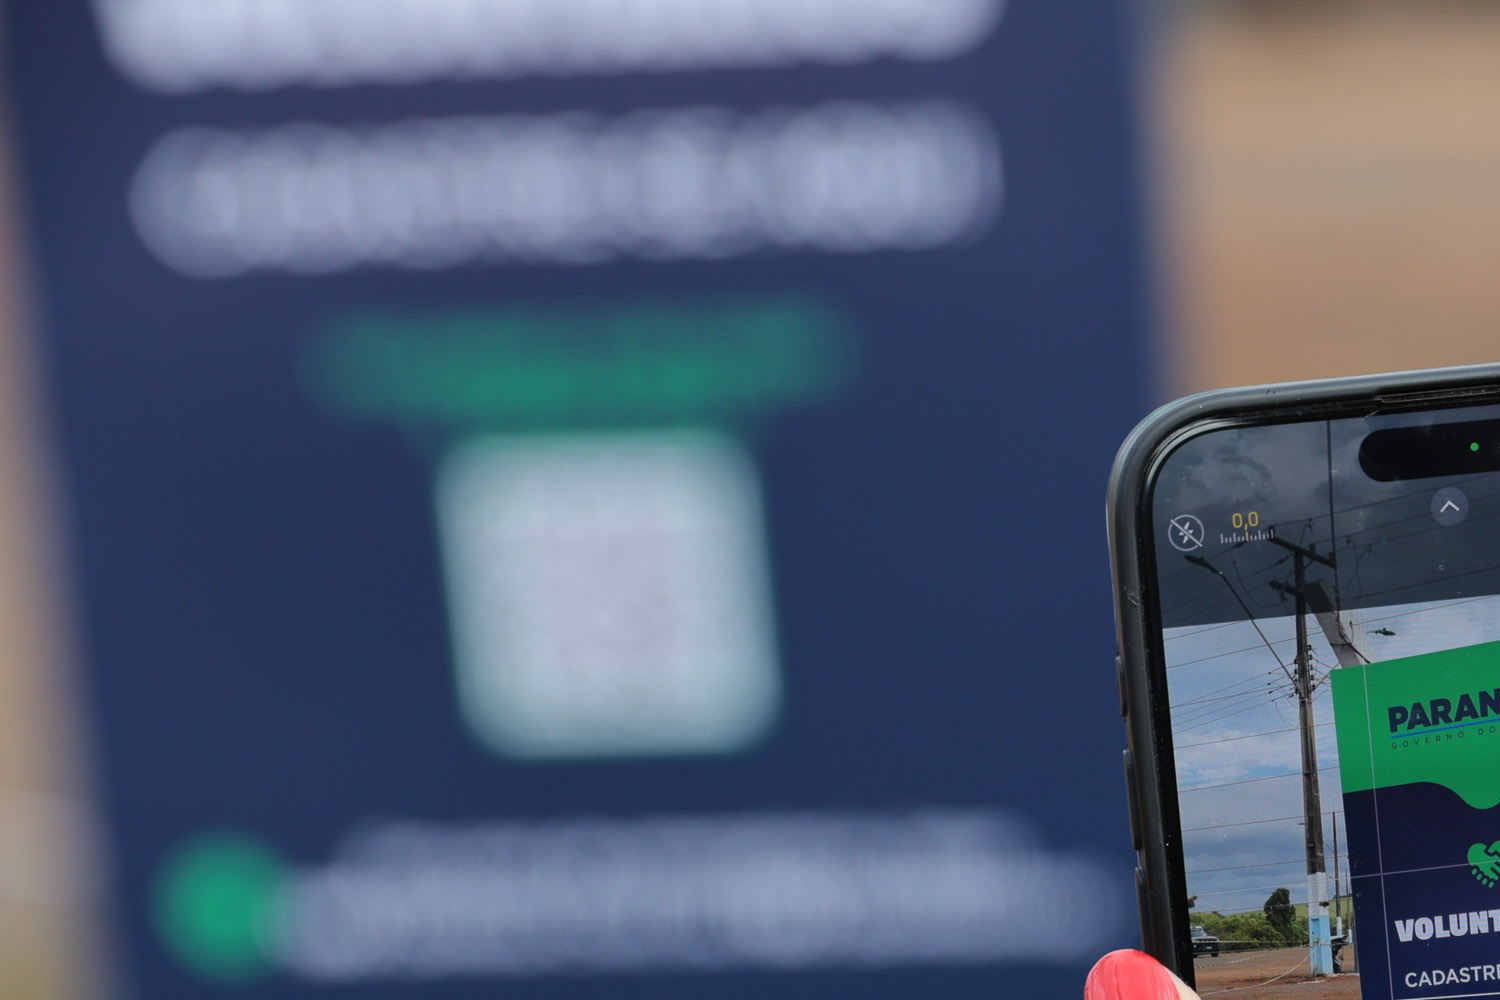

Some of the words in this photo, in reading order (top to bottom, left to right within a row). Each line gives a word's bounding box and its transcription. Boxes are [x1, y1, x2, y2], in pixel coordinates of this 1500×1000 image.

[1232, 511, 1259, 531] 0,0
[1391, 731, 1464, 749] GOVERNO
[1478, 726, 1496, 735] DO
